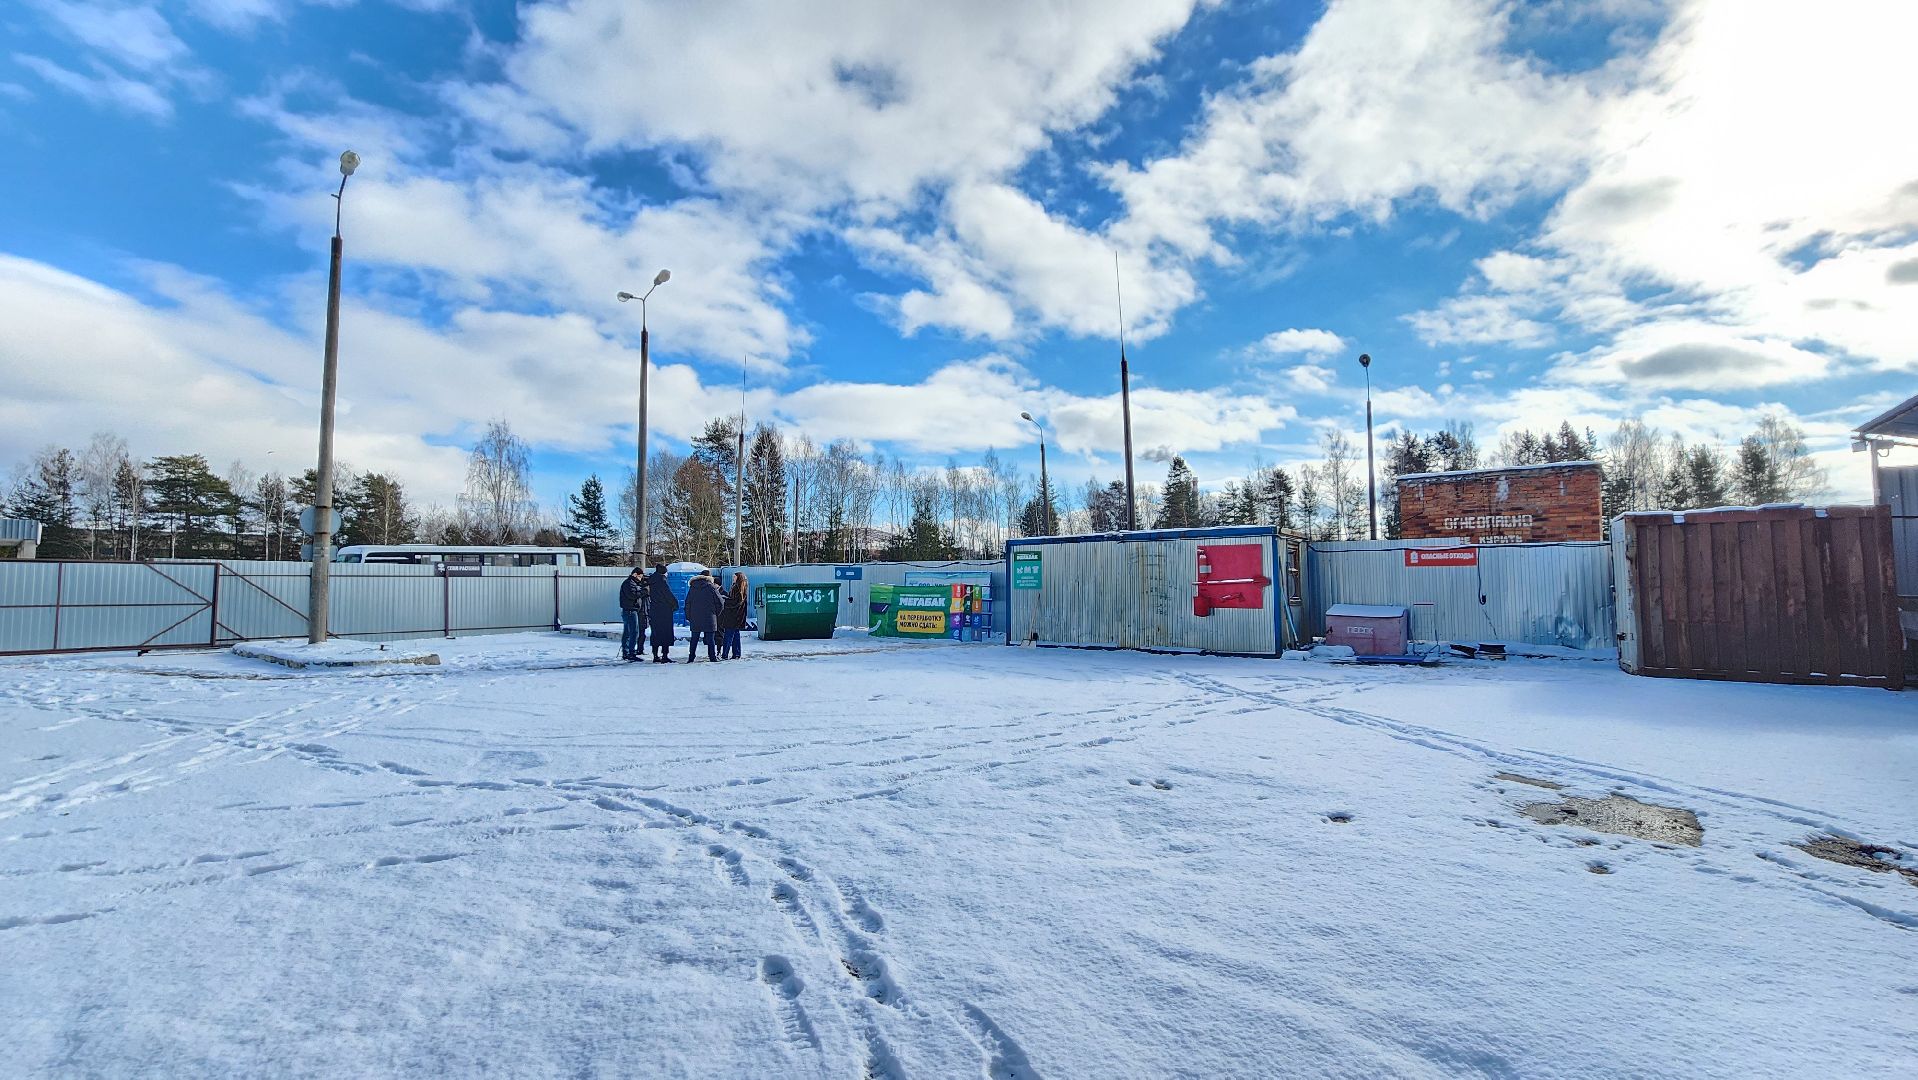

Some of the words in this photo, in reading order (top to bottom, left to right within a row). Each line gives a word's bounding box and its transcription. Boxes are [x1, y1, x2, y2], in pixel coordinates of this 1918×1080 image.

[1444, 514, 1533, 530] ОГНЕОПАСНО
[1479, 535, 1523, 545] КУРИТЬ
[1421, 552, 1449, 560] ОПАСНЫЕ
[1449, 552, 1475, 560] ОТХОДЫ
[899, 597, 946, 607] МЕГАБАК
